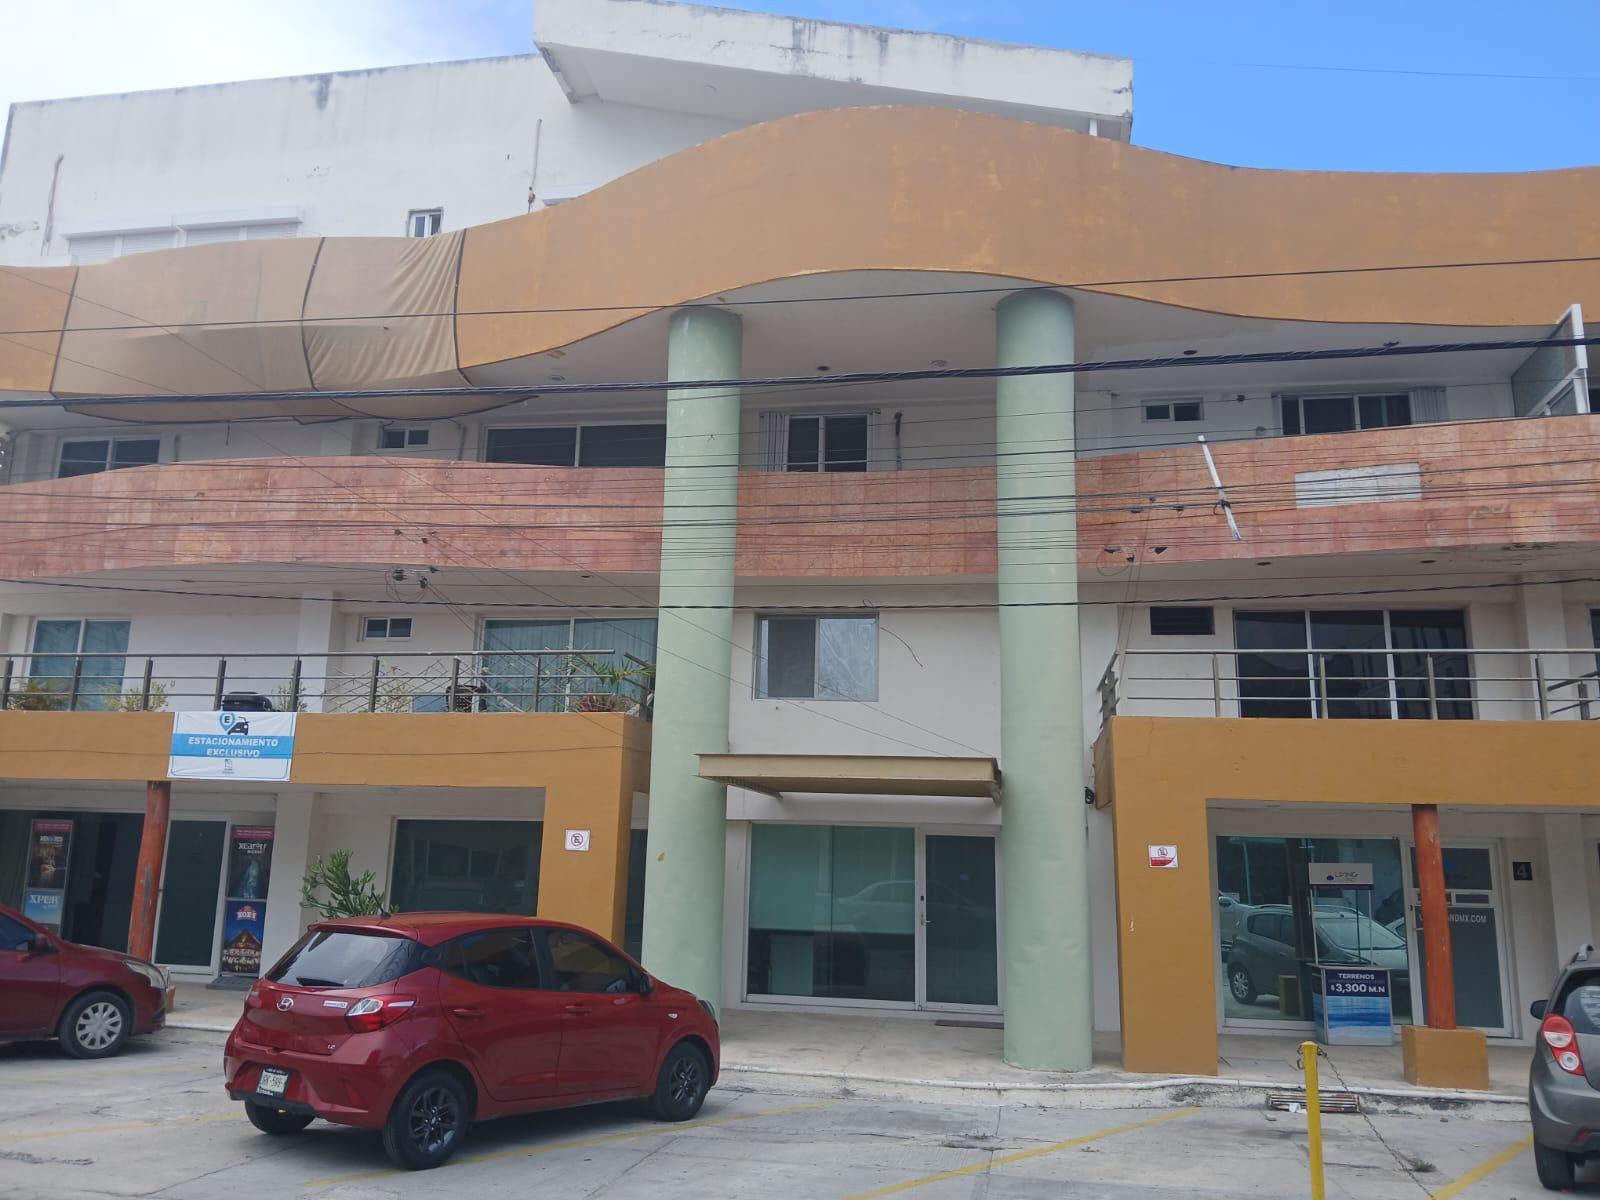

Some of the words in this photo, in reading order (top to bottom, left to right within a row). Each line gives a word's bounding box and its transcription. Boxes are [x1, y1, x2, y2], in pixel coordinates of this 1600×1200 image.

[188, 736, 279, 747] ESTACIONAMIENTO
[206, 748, 261, 758] EXCLUSIVO
[1516, 864, 1528, 880] 4
